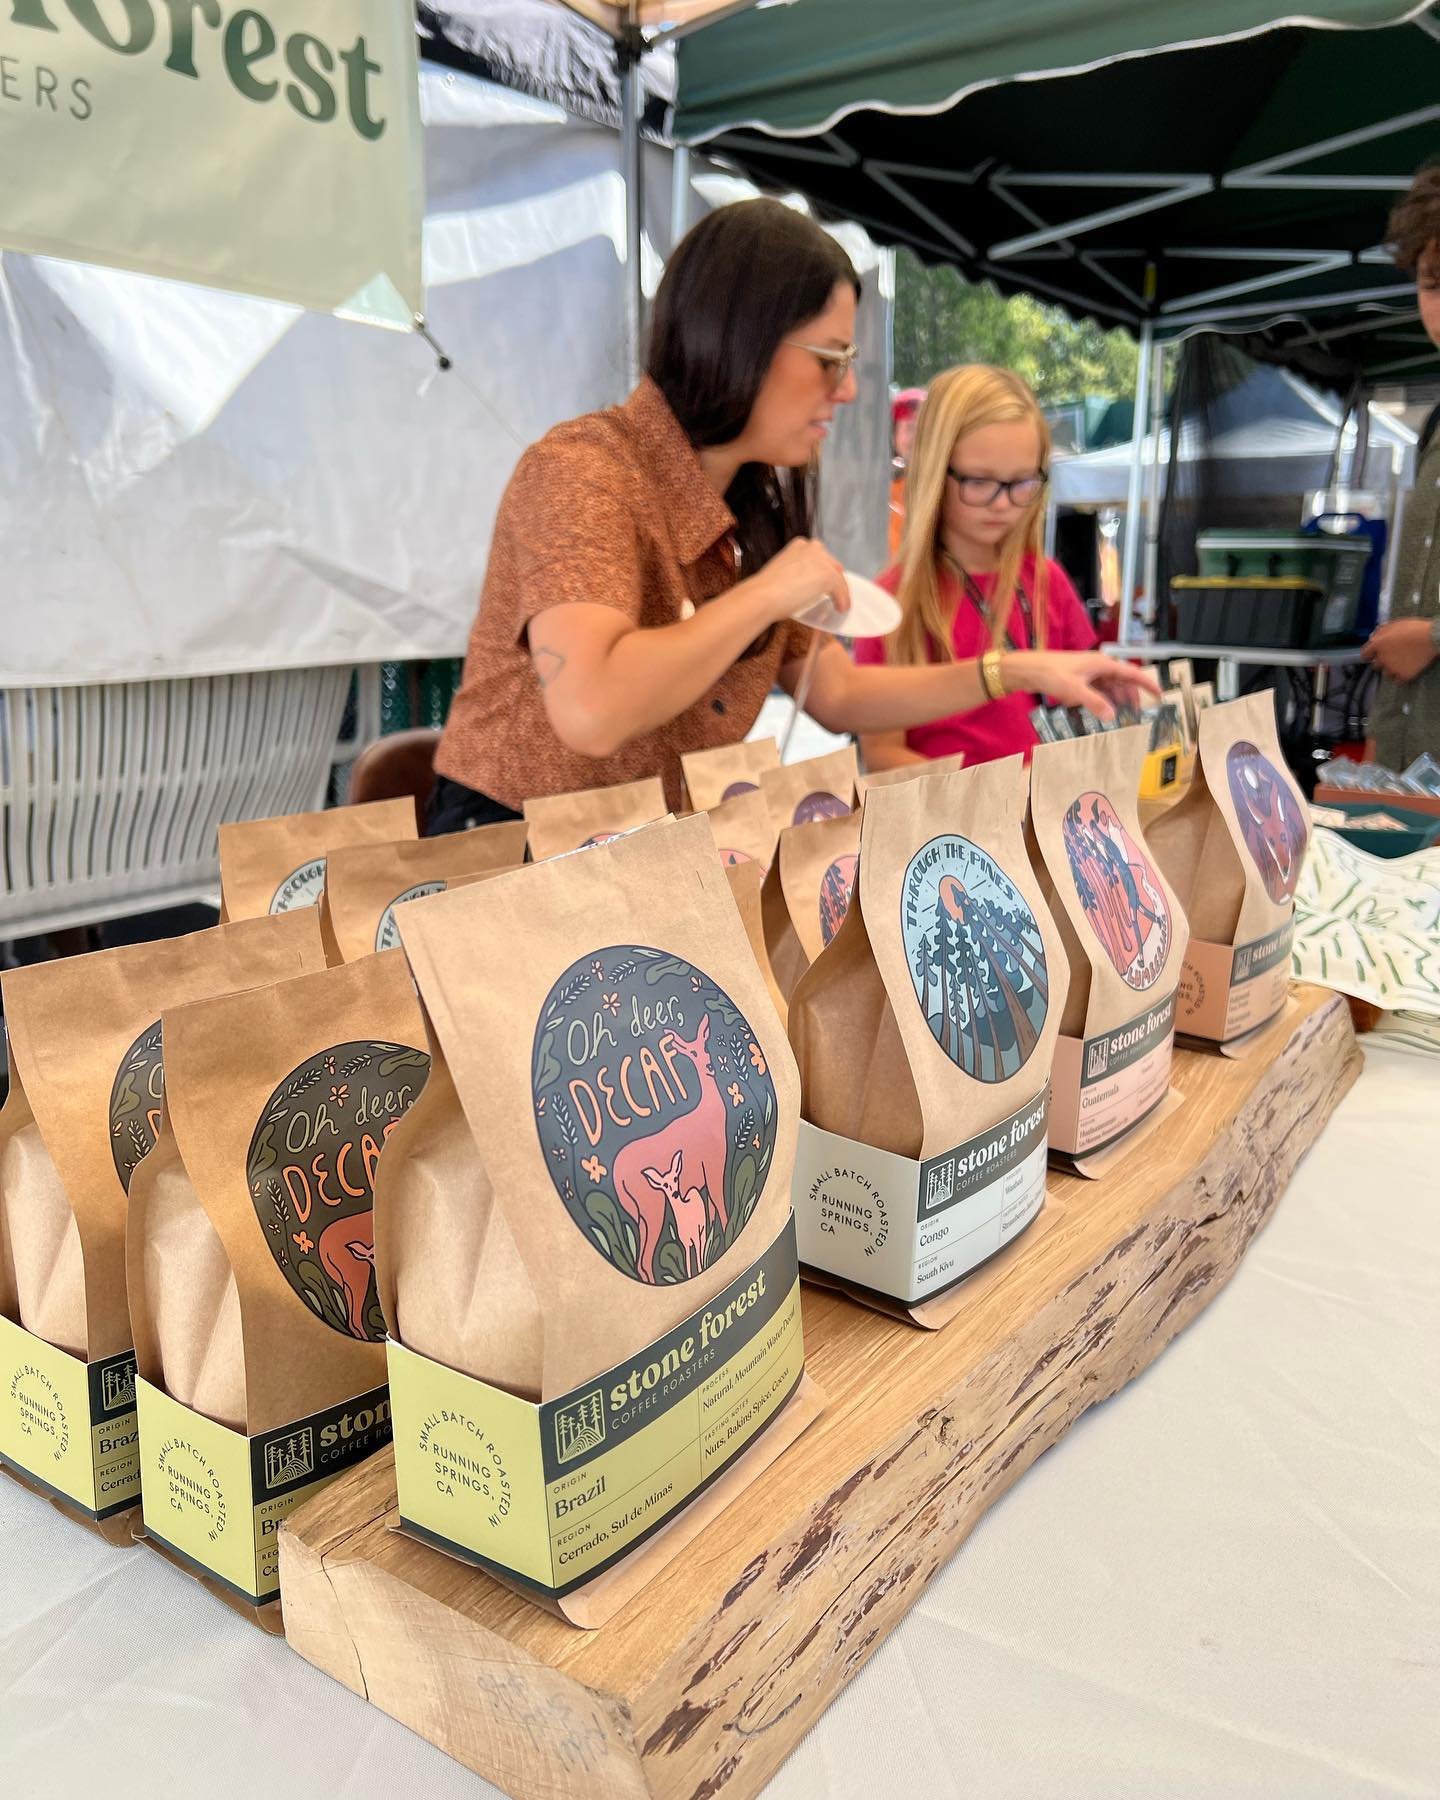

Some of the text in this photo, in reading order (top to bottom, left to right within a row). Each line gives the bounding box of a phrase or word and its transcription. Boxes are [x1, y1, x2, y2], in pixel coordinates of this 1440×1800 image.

[905, 843, 1016, 930] THROUGH THE PINES
[567, 995, 685, 1066] Oh deer,
[1110, 1024, 1145, 1055] stone
[1147, 1003, 1171, 1034] forest
[569, 1034, 688, 1146] DECAF
[1082, 1084, 1119, 1109] Guatemala
[286, 1104, 340, 1153] Oh
[957, 1135, 1008, 1177] stone
[1010, 1099, 1045, 1147] forest
[282, 1116, 400, 1224] DECA
[956, 1170, 983, 1191] COFFEE
[986, 1148, 1017, 1174] ROASTERS
[809, 1168, 889, 1257] SMALL BATCH ROASTED IN
[821, 1193, 872, 1219] RUNNING
[820, 1222, 835, 1235] CA
[920, 1226, 949, 1247] Congo
[916, 1259, 955, 1284] South Kivu
[610, 1270, 767, 1411] stone forest
[611, 1348, 716, 1430] COFFEE ROASTERS
[702, 1378, 734, 1413] Natural,
[734, 1348, 767, 1382] Mountain
[702, 1368, 729, 1395] PROCESS
[10, 1365, 69, 1461] SMALL BATCH ROASTED IN
[19, 1391, 56, 1421] RUNNING
[319, 1400, 391, 1447] ston
[704, 1399, 749, 1442] TASTING NOTES
[20, 1422, 32, 1435] CA
[98, 1418, 130, 1435] ORIGIN
[100, 1431, 139, 1454] Braz
[704, 1437, 727, 1460] Nuts,
[726, 1411, 752, 1441] Baking
[321, 1434, 369, 1463] COFFEE
[433, 1443, 491, 1479] RUNNING
[100, 1460, 133, 1477] REGION
[101, 1468, 141, 1492] Cerrad
[168, 1465, 211, 1499] RUNNING
[419, 1410, 511, 1527] SMALL BATCH ROASTED IN
[553, 1471, 587, 1494] ORIGIN
[158, 1438, 226, 1541] SMALL BATCH ROASTED IN
[170, 1498, 183, 1512] CA
[260, 1497, 295, 1515] ORIGIN
[436, 1480, 454, 1497] CA
[555, 1475, 606, 1519] Brazil
[557, 1523, 591, 1546] REGION
[558, 1482, 673, 1565] Cerrado, Sul de Minas
